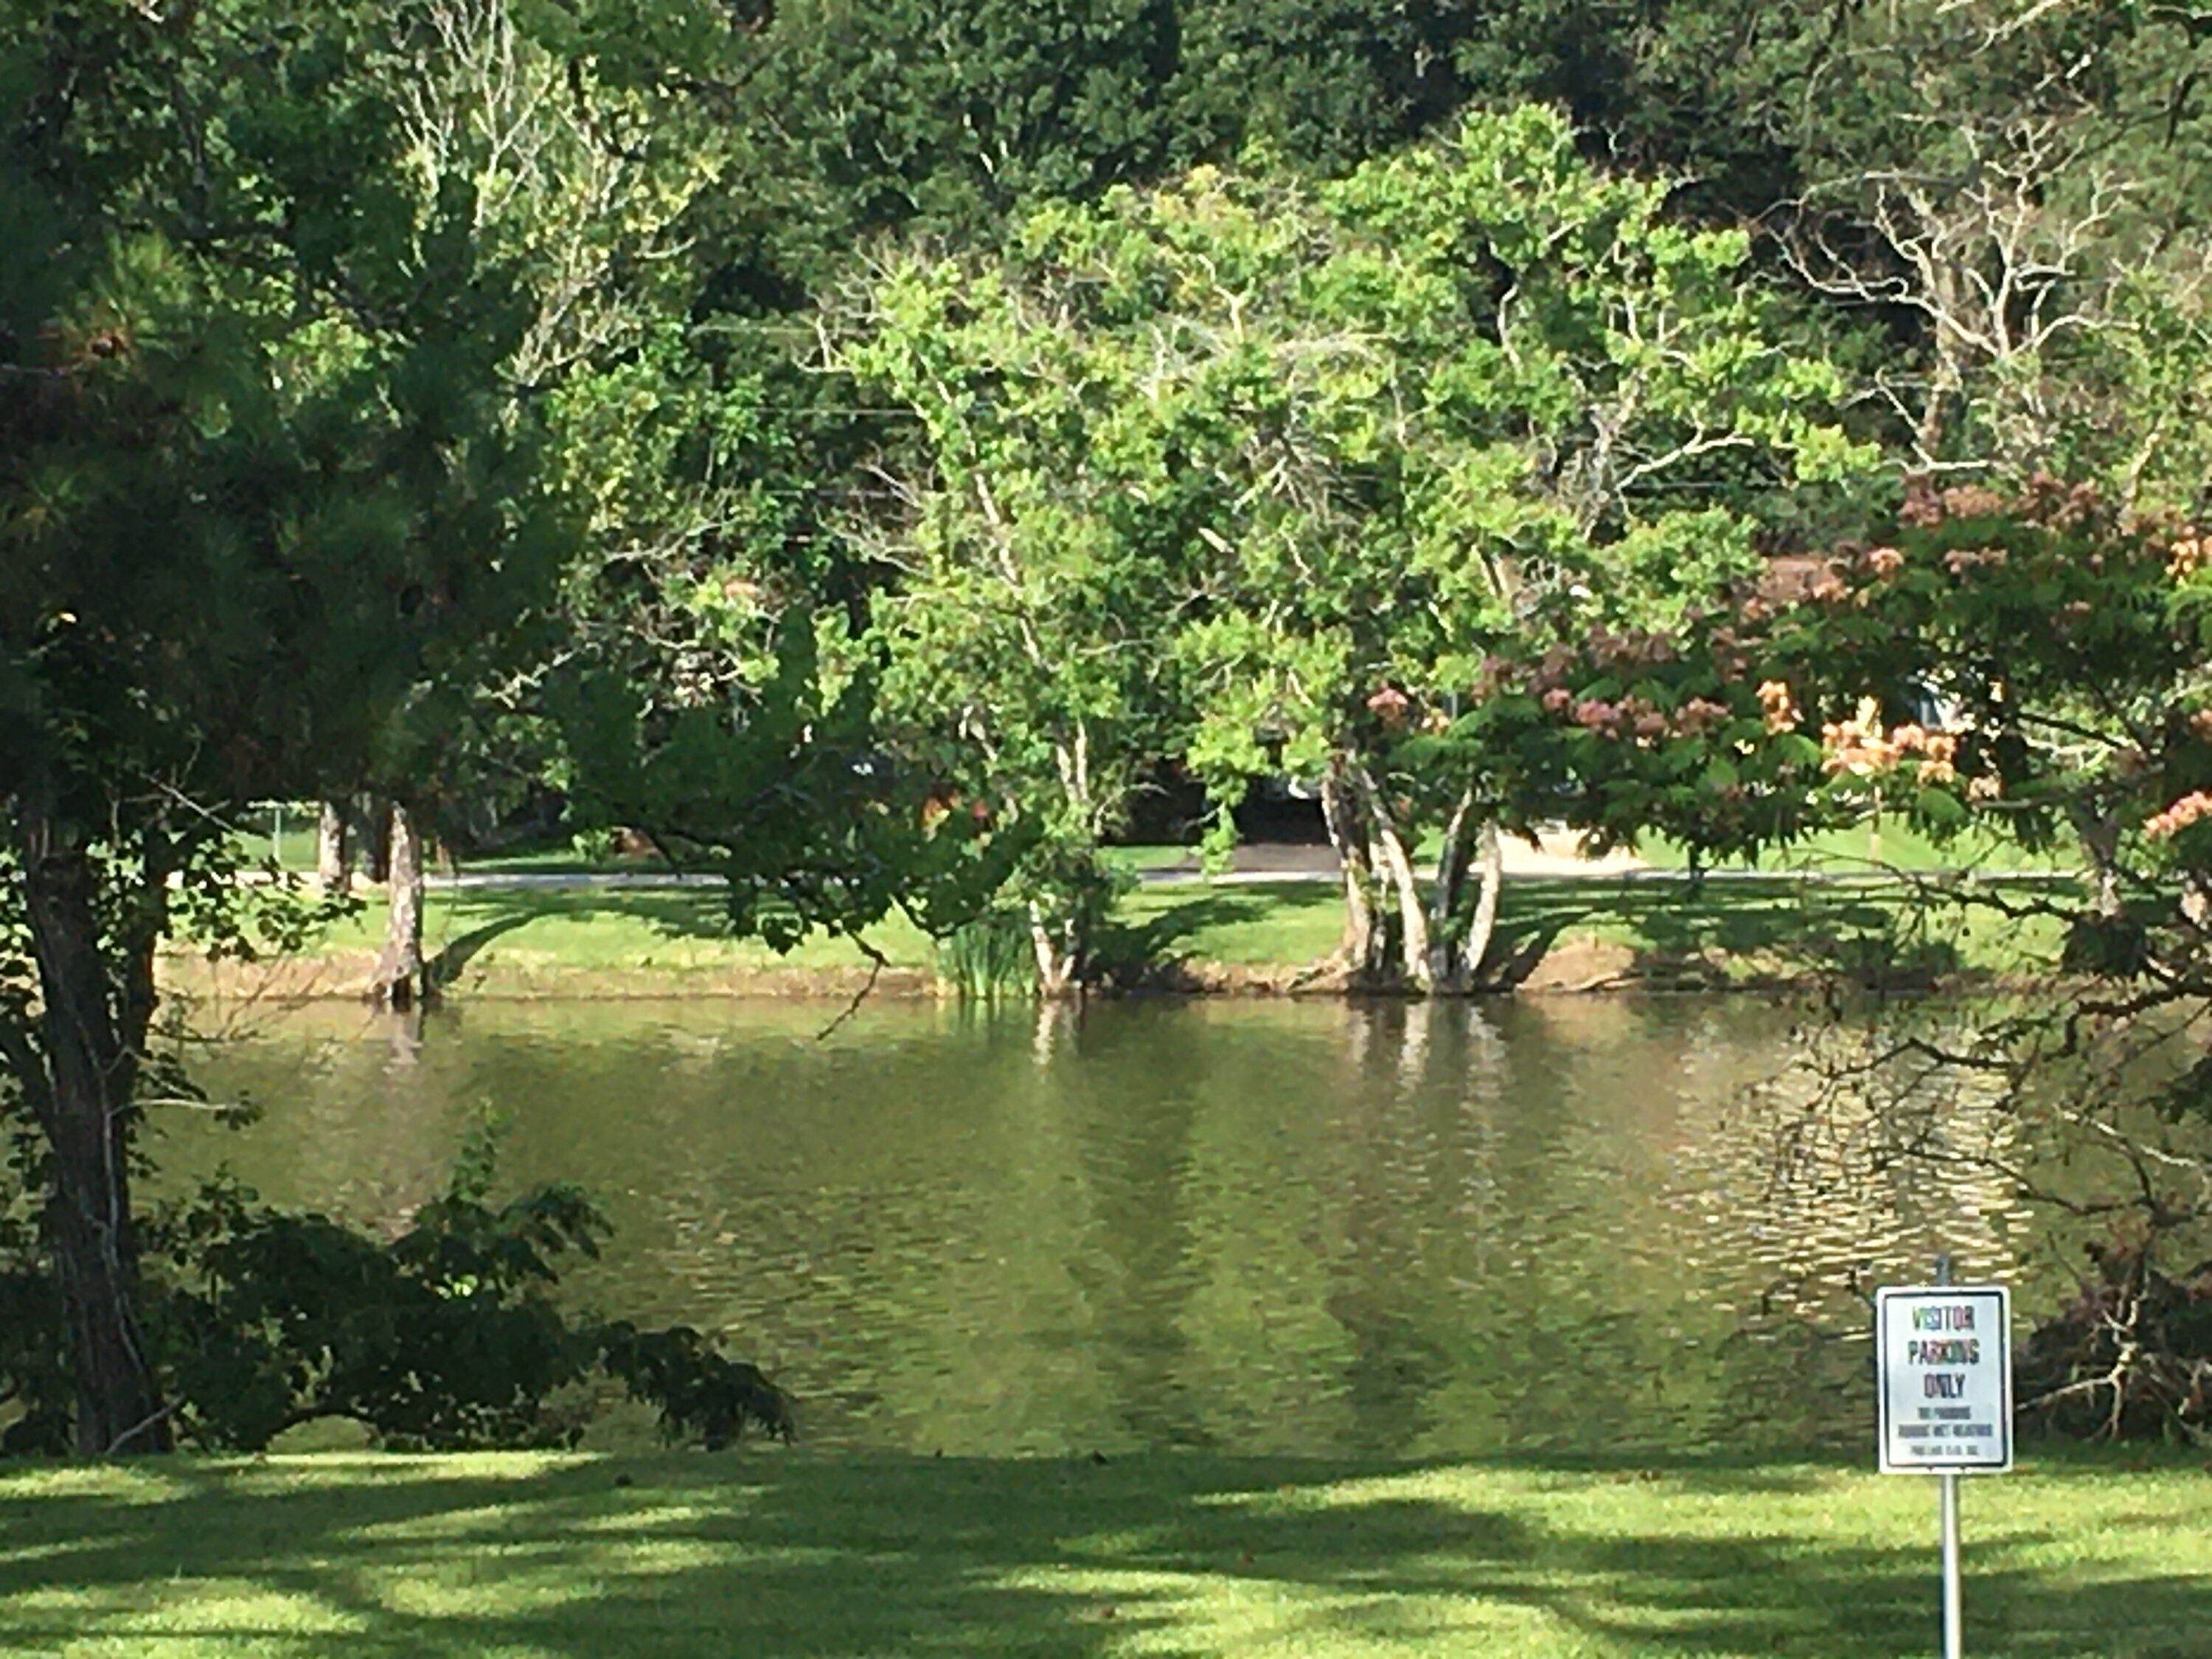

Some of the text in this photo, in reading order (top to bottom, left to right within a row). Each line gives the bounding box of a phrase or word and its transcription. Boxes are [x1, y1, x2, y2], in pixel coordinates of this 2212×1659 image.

[1912, 1305, 1975, 1330] VISITOR
[1907, 1338, 1980, 1365] PARKING
[1924, 1372, 1965, 1399] ONLY
